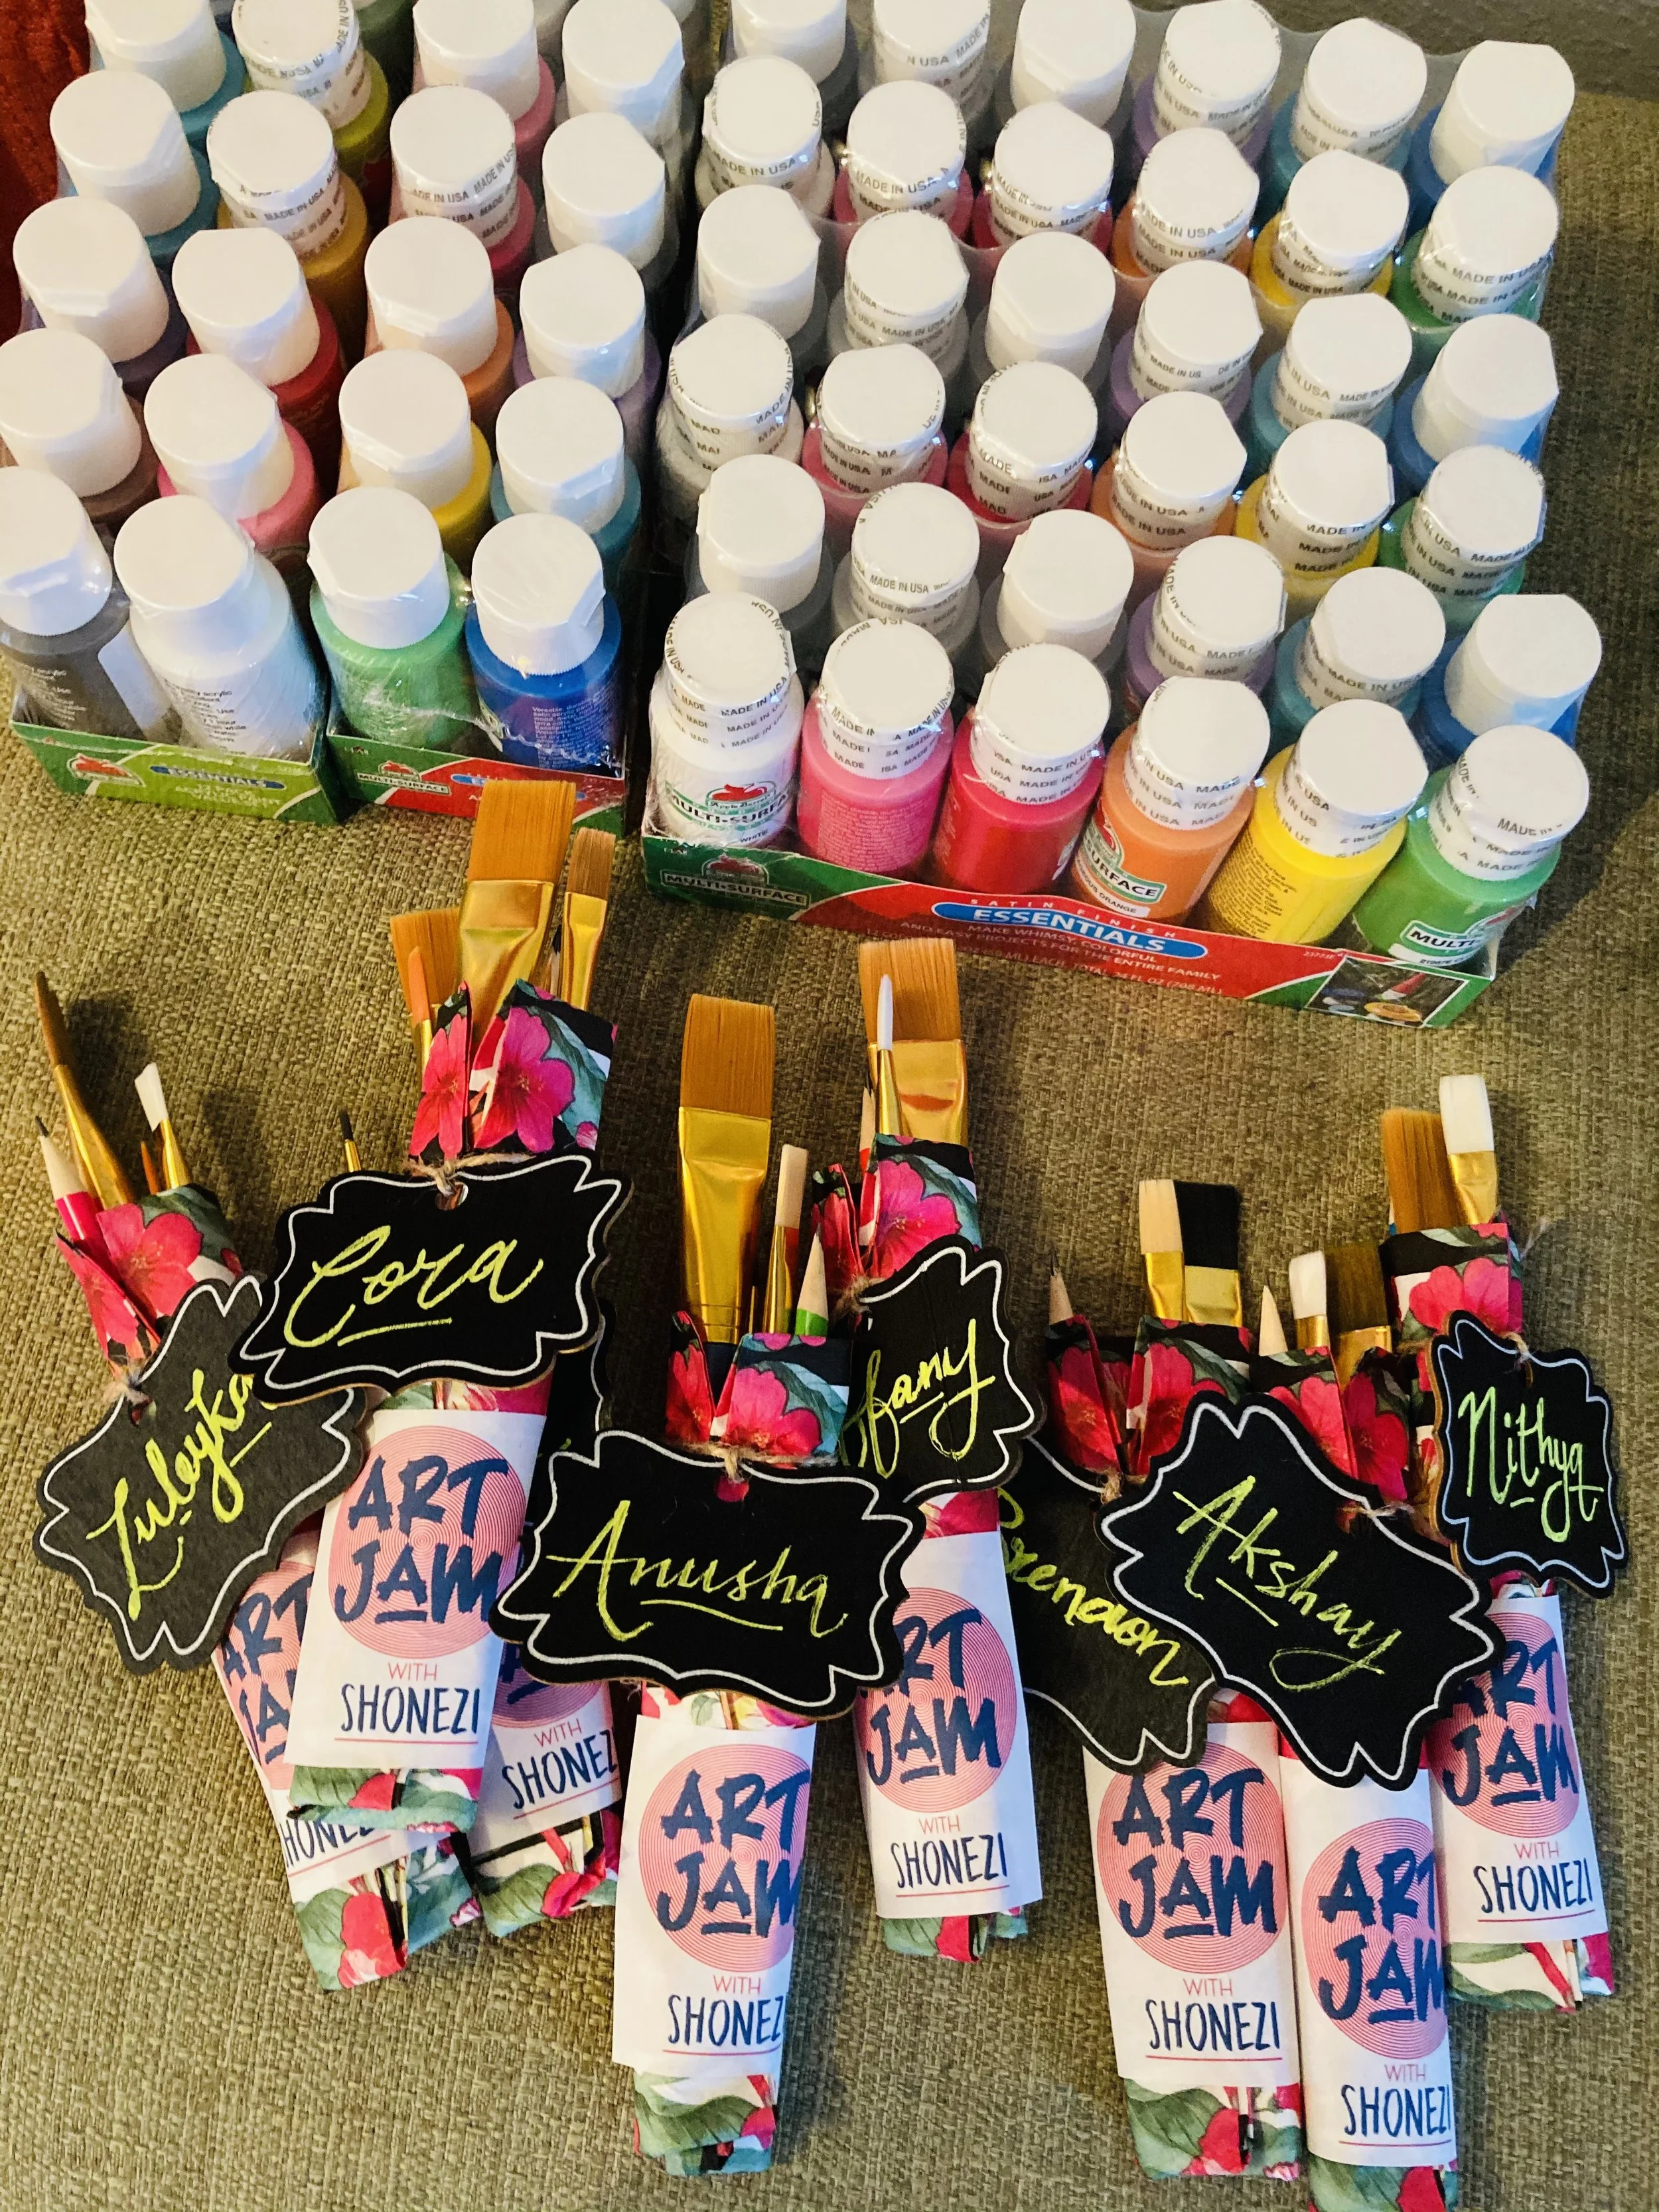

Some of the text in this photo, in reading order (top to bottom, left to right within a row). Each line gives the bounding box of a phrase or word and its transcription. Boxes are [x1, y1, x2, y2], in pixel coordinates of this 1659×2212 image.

[920, 56, 949, 66] USA
[750, 167, 764, 177] IN
[769, 158, 797, 175] USA
[434, 160, 505, 203] IN USA MADE IN
[853, 170, 889, 193] MADE
[892, 184, 903, 194] IN
[1170, 226, 1185, 236] IN
[1187, 227, 1216, 239] USA
[1170, 247, 1184, 258] IN
[1189, 247, 1216, 258] USA
[1453, 265, 1515, 284] MADE IN
[859, 291, 877, 309] USA
[1447, 289, 1508, 305] MADE IN
[882, 326, 912, 337] MADE
[1150, 354, 1175, 374] MADE
[1303, 378, 1329, 400] USA
[848, 463, 871, 476] USA
[1140, 498, 1189, 516] IN USA
[1138, 522, 1187, 536] IN USA
[1299, 542, 1342, 554] MADE
[1435, 530, 1512, 563] USA MADE
[1295, 562, 1337, 572] MADE
[1416, 539, 1456, 577] IN USA
[869, 574, 929, 594] MADE IN USA
[1422, 579, 1447, 595] USA
[867, 595, 893, 612] MADE
[1171, 631, 1246, 660] USA MADE
[1171, 655, 1195, 674] USA
[1328, 668, 1387, 692] MADE IN
[682, 676, 788, 717] MADE MADE IN USA
[727, 711, 770, 733] MADE IN
[831, 705, 863, 734] MADE
[731, 733, 760, 749] MADE
[832, 730, 865, 753] MADE
[834, 751, 865, 769] MADE
[1021, 759, 1078, 774] MADE IN
[990, 767, 1058, 788] USA MADE
[1157, 768, 1241, 793] USA MADE
[1016, 794, 1058, 804] MADE
[1153, 788, 1183, 810] USA
[1287, 796, 1299, 816] IN
[1305, 789, 1330, 811] USA
[1150, 809, 1180, 826] USA
[1281, 818, 1293, 834] IN
[1486, 843, 1532, 857] MADE
[1477, 859, 1523, 871] MADE
[666, 874, 804, 904] MULTI-SURFACE
[1099, 893, 1137, 914] ORANGE
[973, 909, 1166, 952] ESSENTIALS
[968, 924, 1012, 935] MAKE
[1080, 940, 1157, 963] COLORFUL
[977, 934, 1047, 947] PROJECTS
[1049, 942, 1079, 954] FOR
[1114, 956, 1165, 972] ENTIRE
[1167, 966, 1221, 980] FAMILY
[348, 1455, 510, 1537] ART
[545, 1500, 849, 1642] Anusha
[334, 1543, 501, 1625] JAM
[1173, 1475, 1402, 1692] Akshay
[889, 1608, 982, 1698] RT
[387, 1661, 438, 1681] WITH
[341, 1684, 481, 1735] SHONEZI
[534, 1718, 583, 1748] WITH
[867, 1696, 1001, 1785] JAM
[1441, 1723, 1579, 1806] JAM
[660, 1768, 810, 1849] ART
[1112, 1767, 1265, 1852] ART
[918, 1813, 961, 1835] WITH
[891, 1832, 1007, 1889] SHONEZI
[1514, 1840, 1559, 1860] WITH
[1318, 1845, 1437, 1931] ART
[1473, 1857, 1593, 1914] SHONEZI
[1118, 1854, 1277, 1940] JAM
[713, 1974, 760, 1995] WITH
[1183, 1977, 1233, 1997] WITH
[1145, 1998, 1281, 2052] SHONEZI
[1384, 2063, 1427, 2082] WITH
